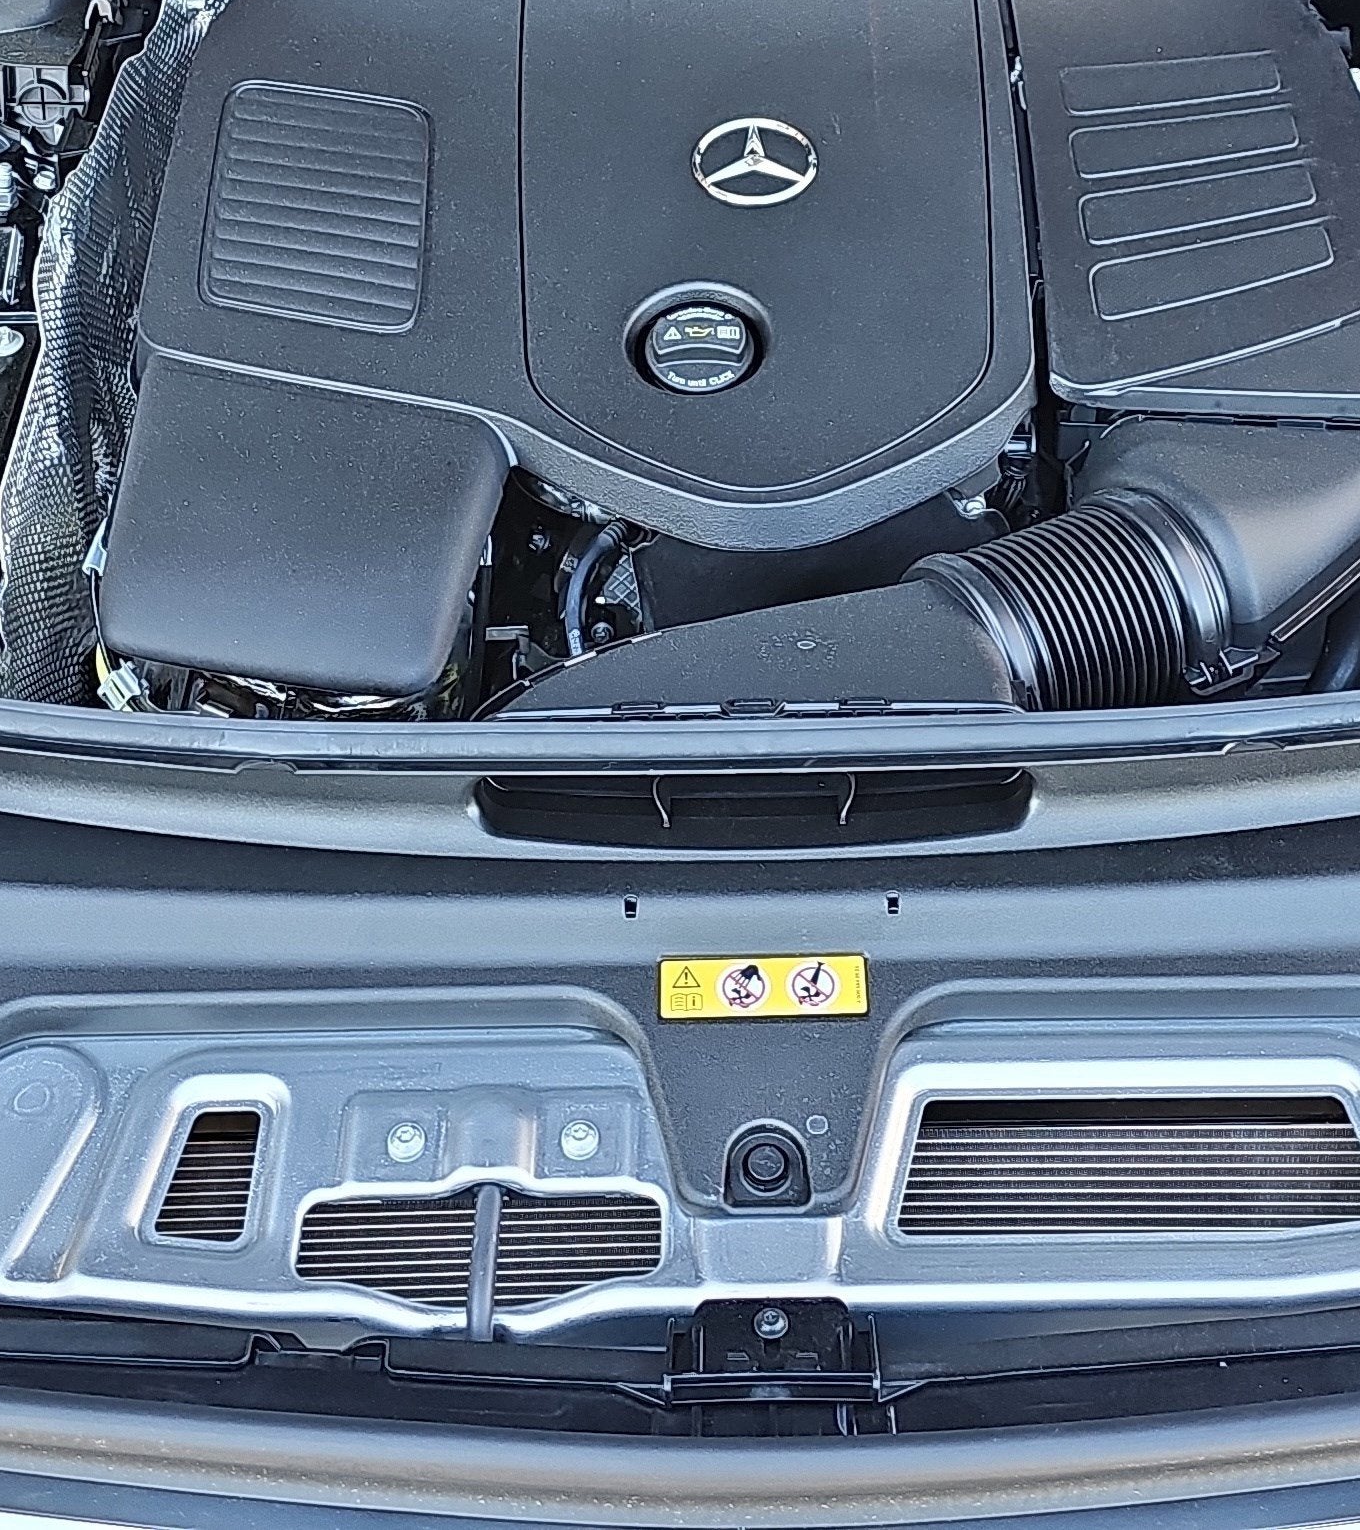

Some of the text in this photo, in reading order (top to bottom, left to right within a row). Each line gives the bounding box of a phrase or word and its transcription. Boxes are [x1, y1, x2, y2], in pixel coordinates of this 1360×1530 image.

[667, 370, 736, 387] Turn until CLICK
